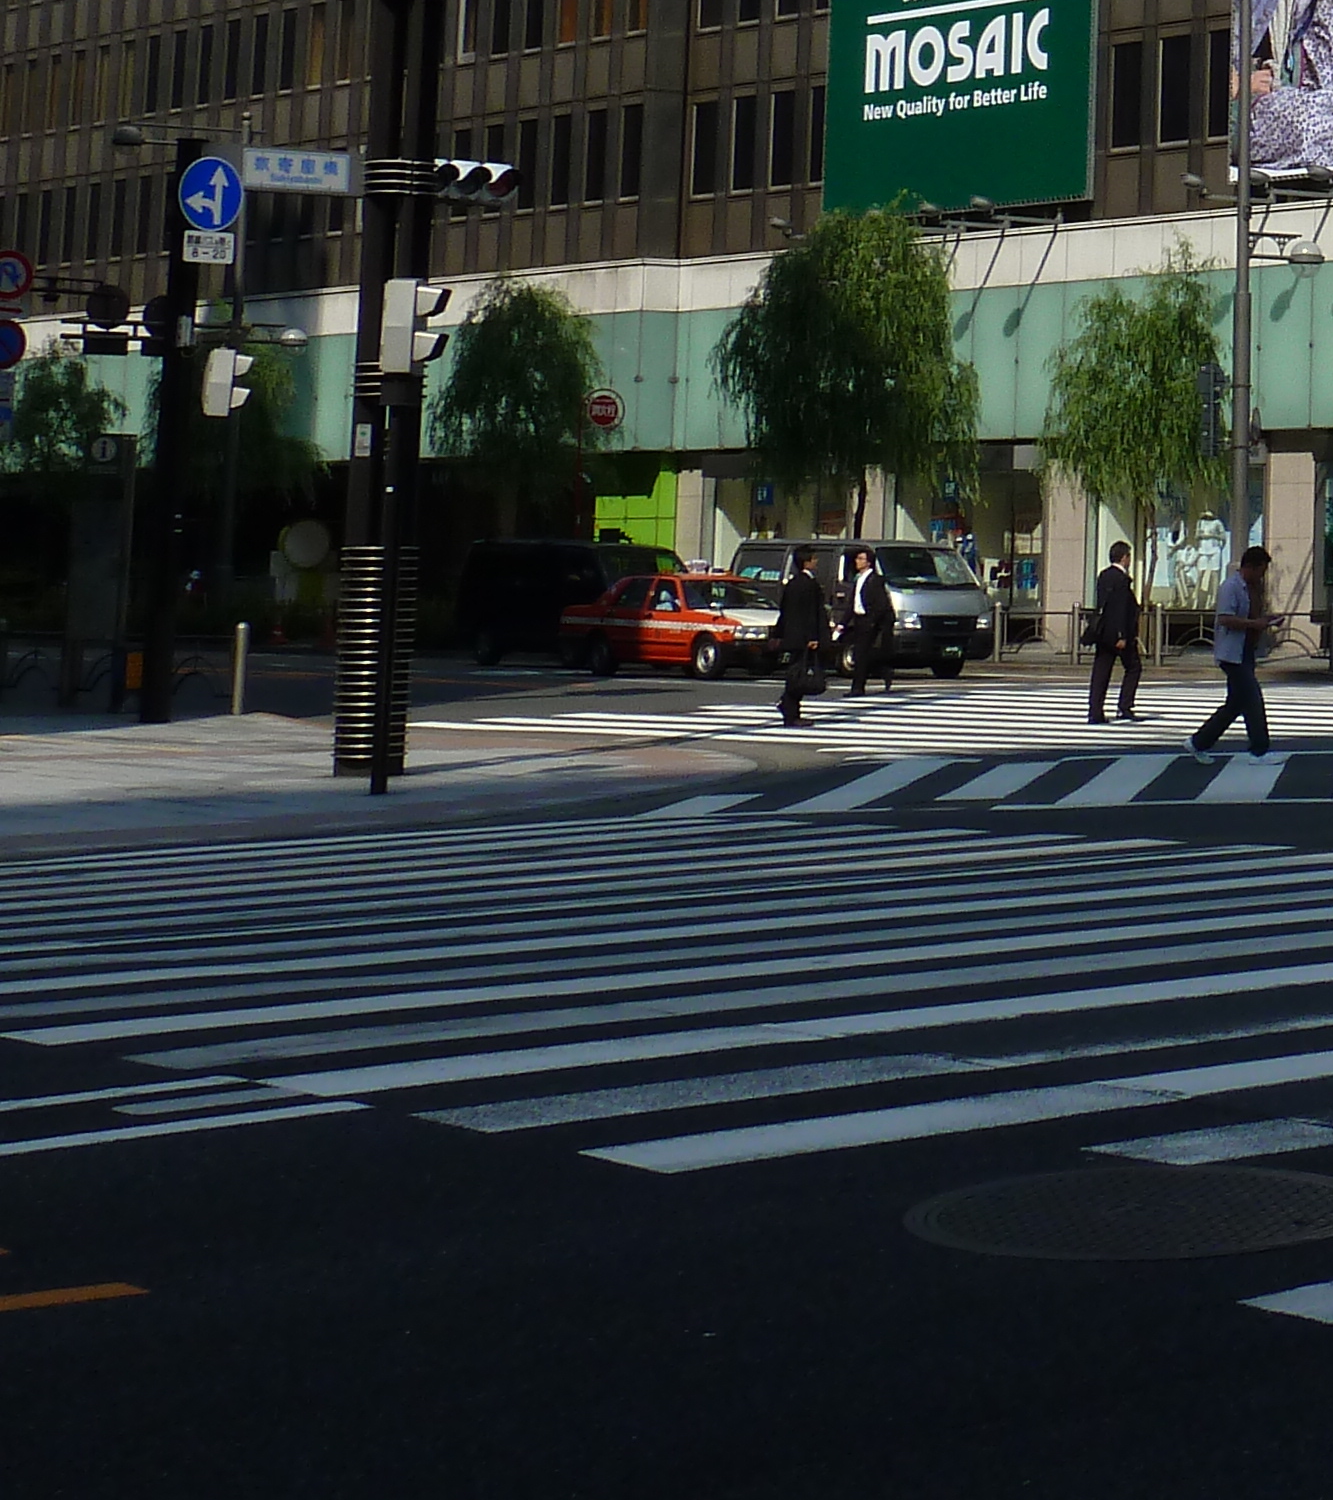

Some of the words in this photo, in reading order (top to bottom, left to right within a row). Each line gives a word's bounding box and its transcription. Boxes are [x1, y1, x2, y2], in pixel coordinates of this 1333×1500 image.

[864, 8, 1050, 94] MOSAIC
[863, 103, 893, 121] New
[896, 96, 946, 119] Quality
[948, 92, 970, 111] for
[973, 87, 1017, 107] Better
[1020, 81, 1047, 101] Life
